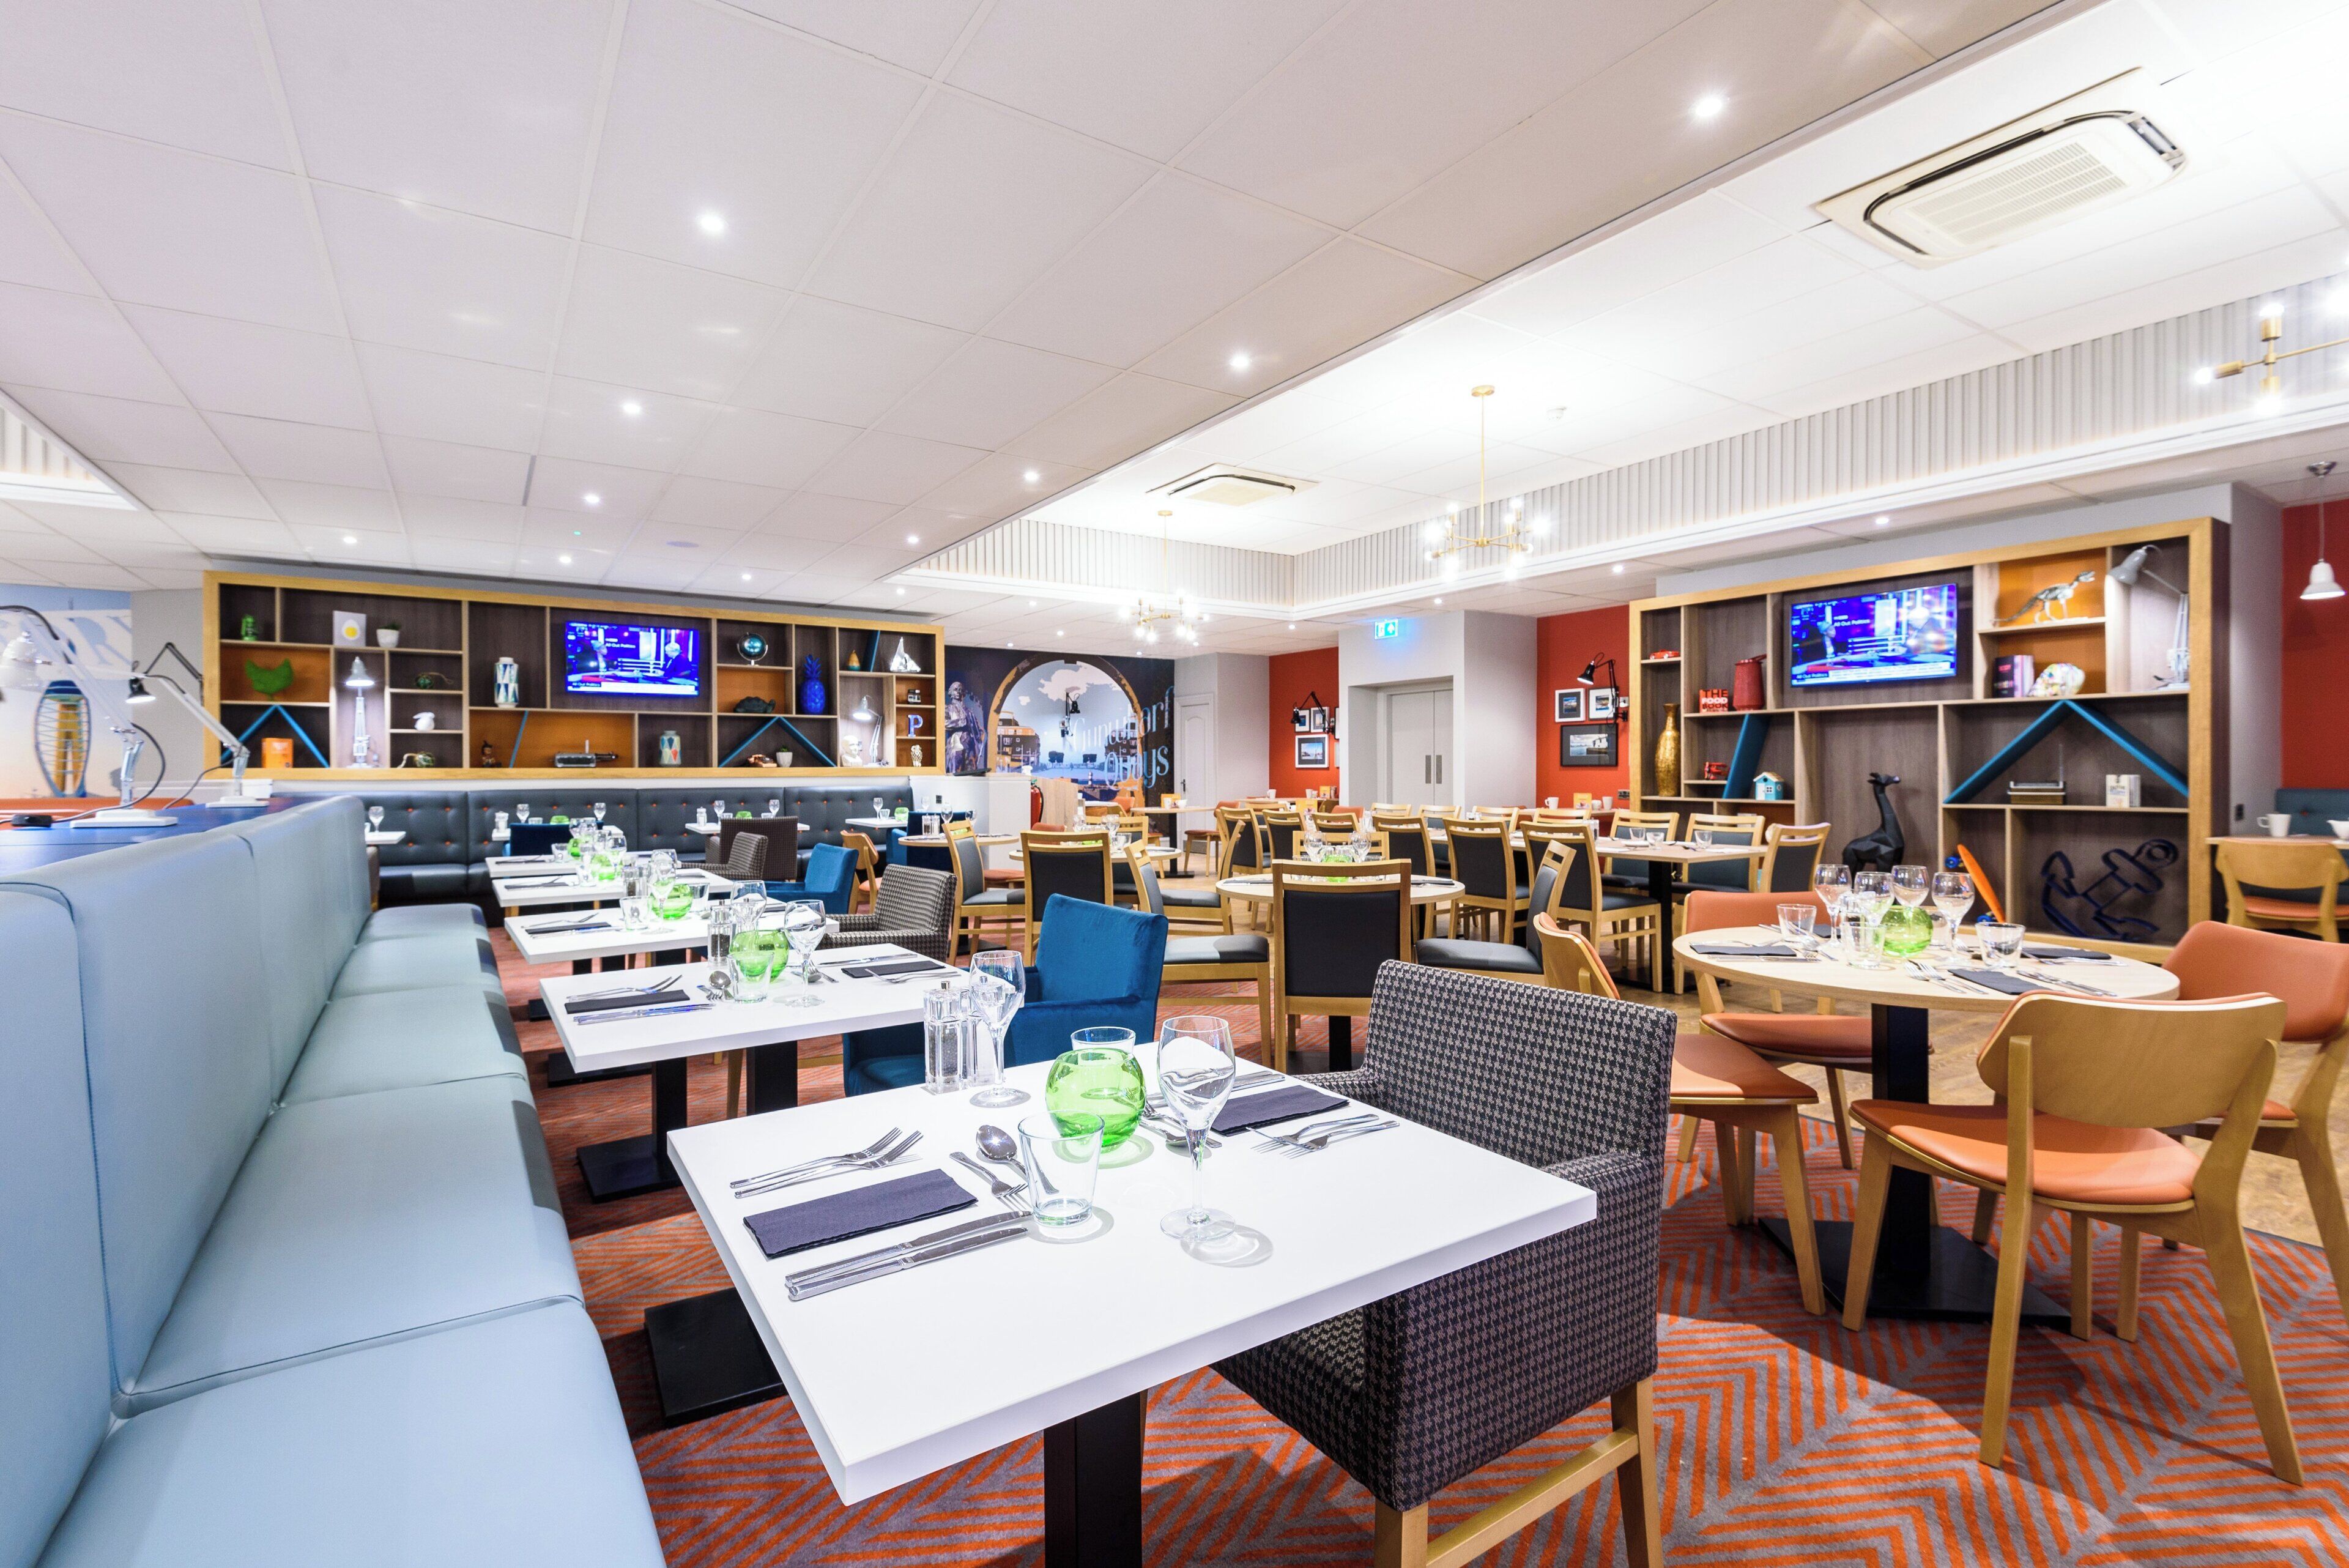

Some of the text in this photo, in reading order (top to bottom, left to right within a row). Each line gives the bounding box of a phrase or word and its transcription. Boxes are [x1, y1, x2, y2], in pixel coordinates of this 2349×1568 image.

[1702, 689, 1727, 697] THE
[908, 715, 923, 737] P
[1074, 685, 1174, 752] Gunwharf
[1104, 745, 1169, 790] Quays
